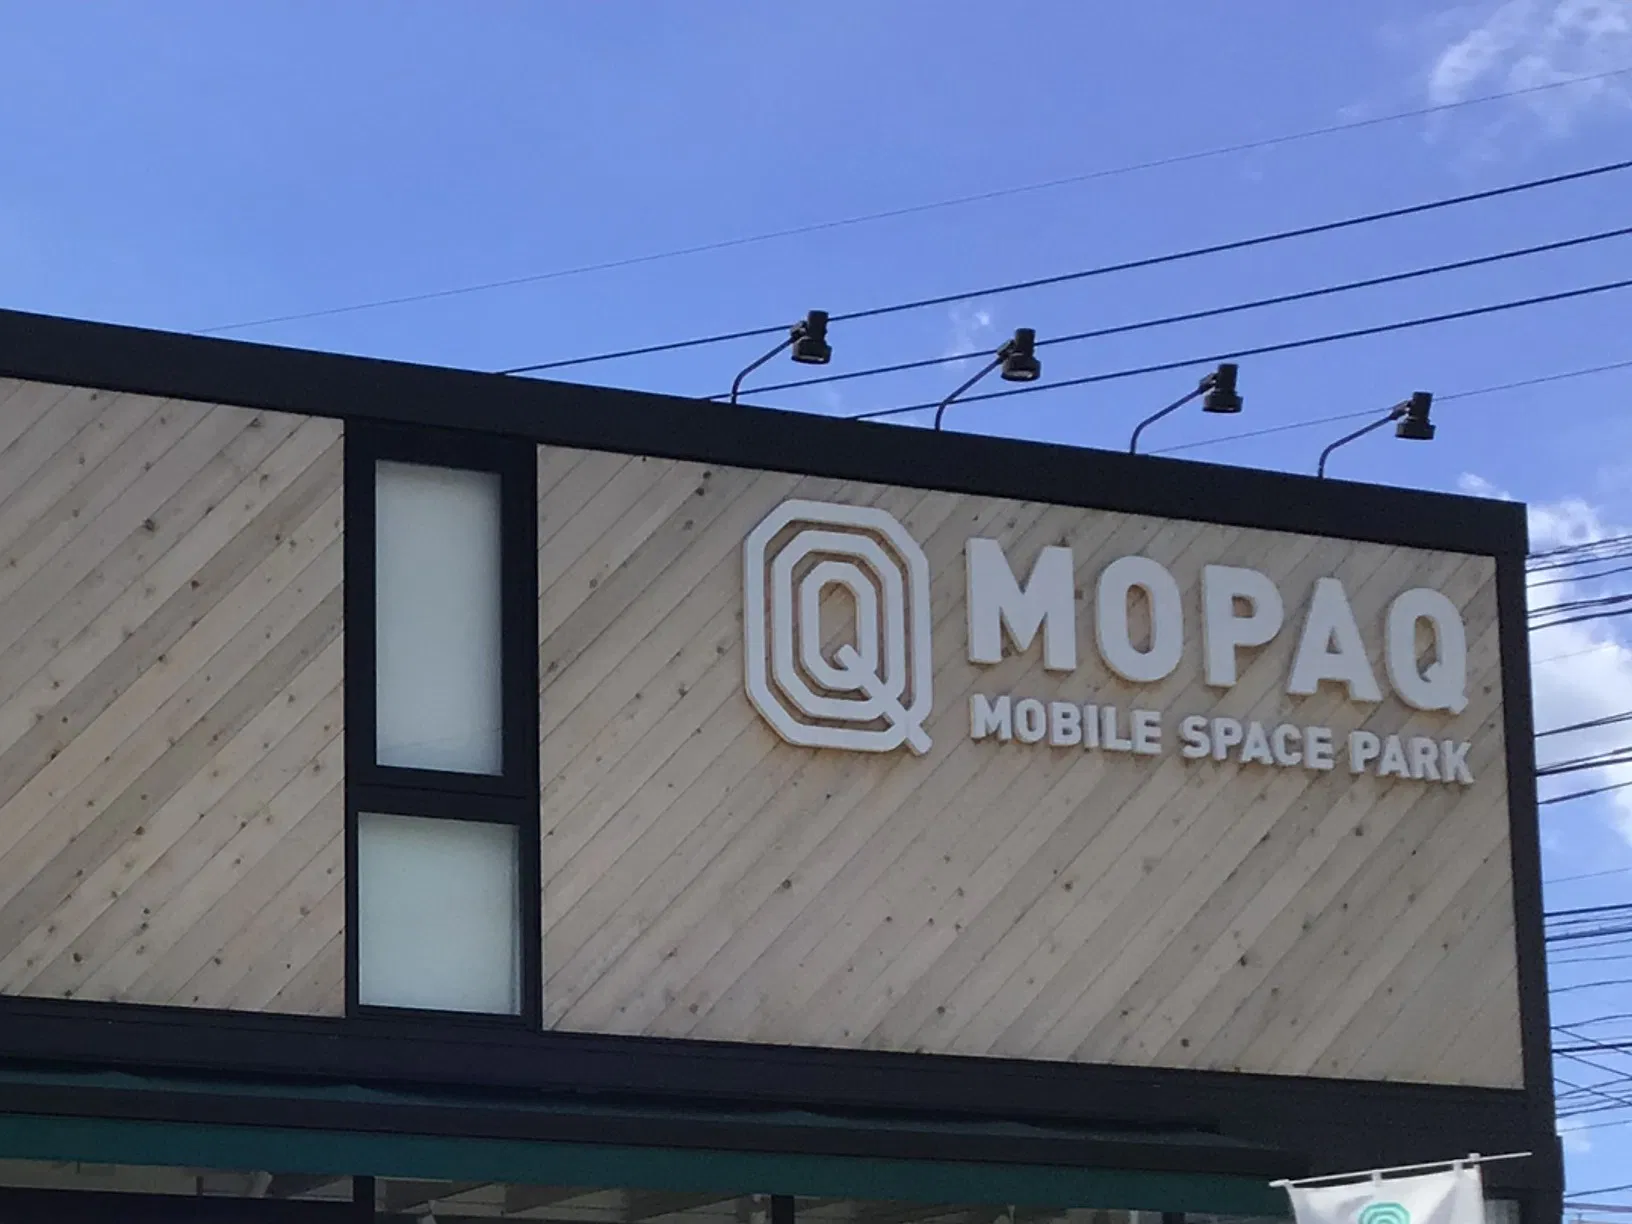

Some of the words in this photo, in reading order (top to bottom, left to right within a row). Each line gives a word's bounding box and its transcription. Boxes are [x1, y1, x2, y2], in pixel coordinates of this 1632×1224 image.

[967, 536, 1470, 714] MOPAQ
[970, 693, 1163, 756] MOBILE
[1180, 714, 1335, 772] SPACE
[1349, 730, 1475, 785] PARK
